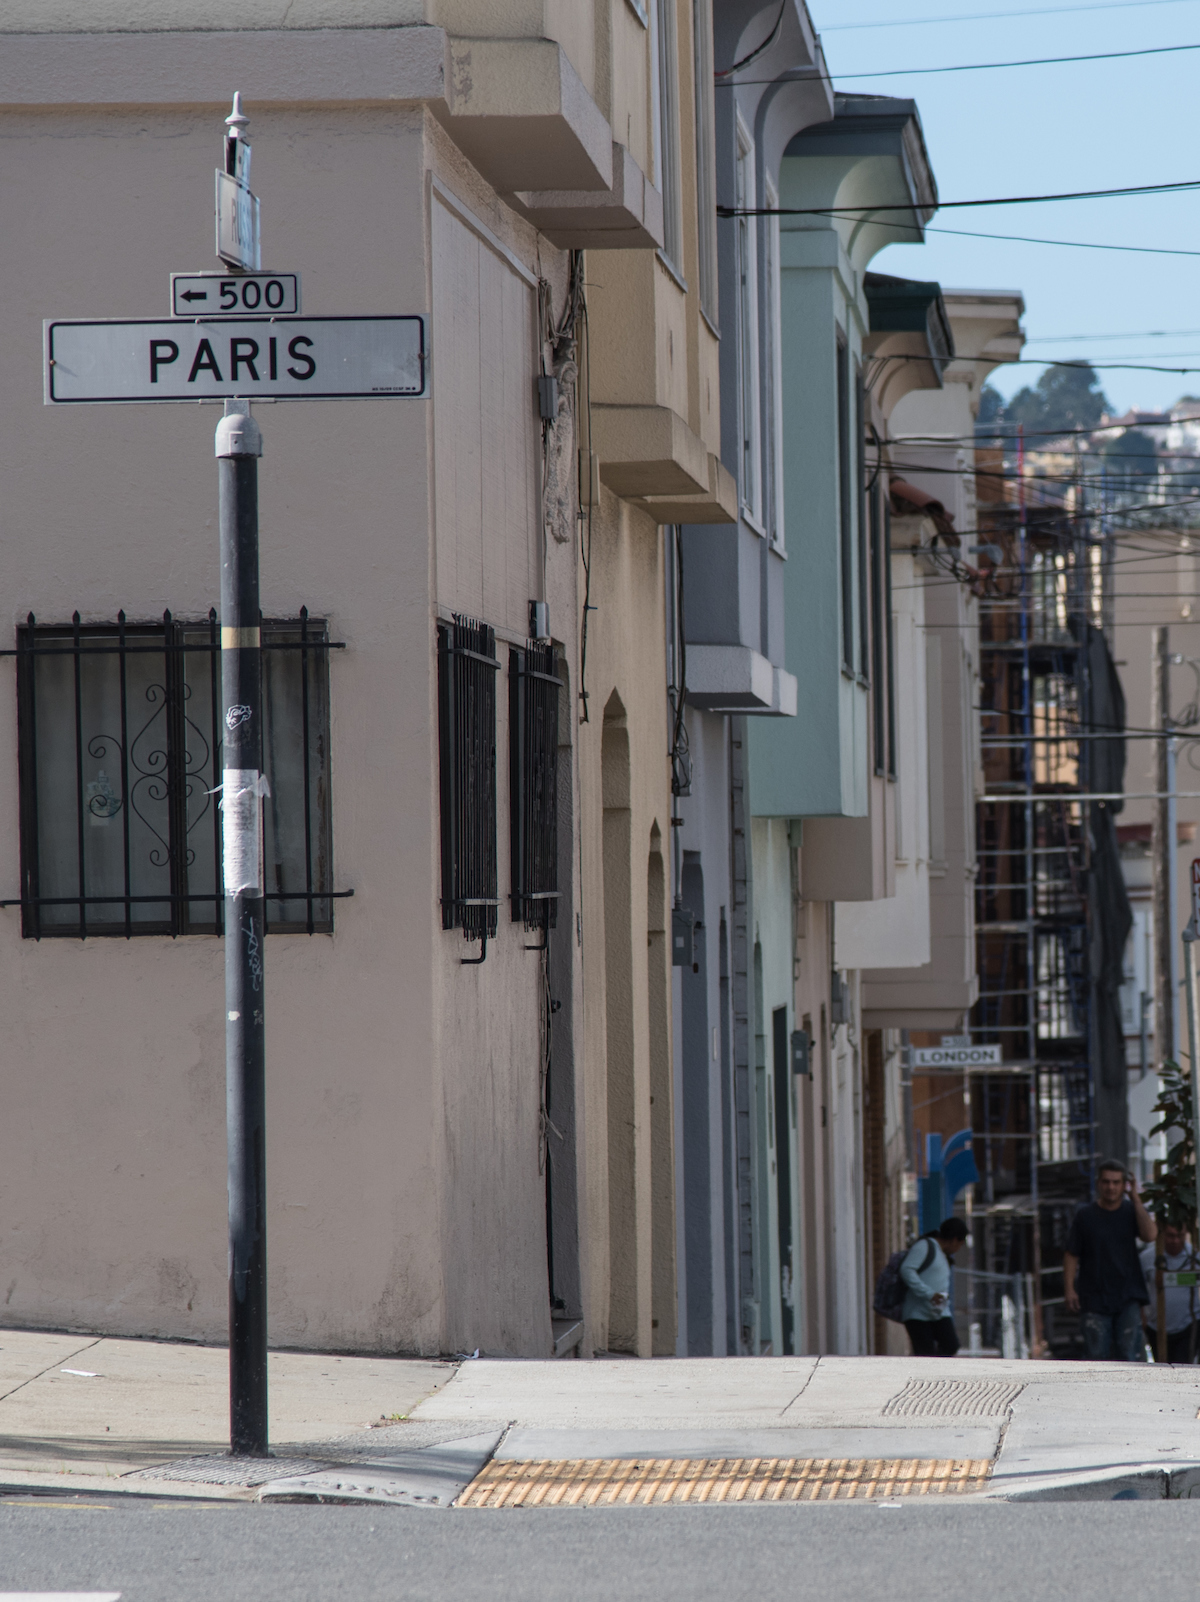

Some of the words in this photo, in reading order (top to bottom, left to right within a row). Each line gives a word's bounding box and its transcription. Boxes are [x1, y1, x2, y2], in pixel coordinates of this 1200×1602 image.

[219, 280, 285, 310] 500
[149, 335, 317, 384] PARIS
[920, 1050, 995, 1063] LONDON
